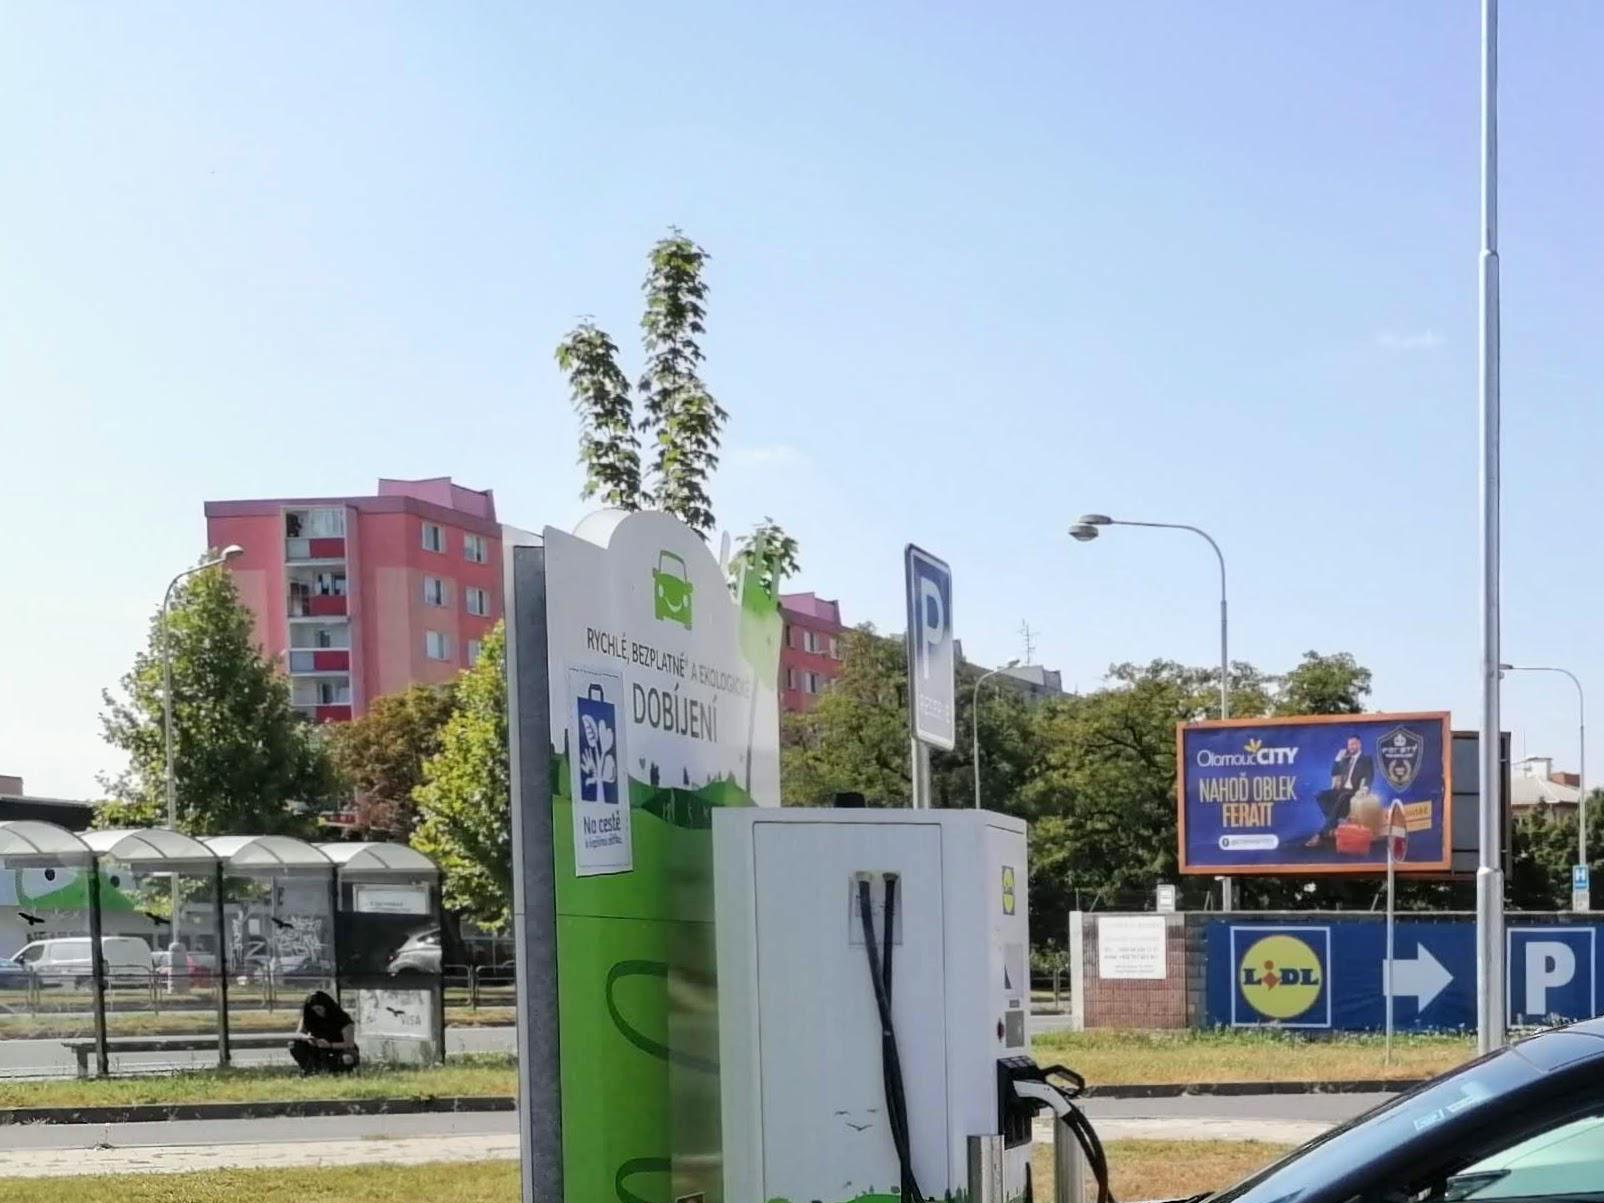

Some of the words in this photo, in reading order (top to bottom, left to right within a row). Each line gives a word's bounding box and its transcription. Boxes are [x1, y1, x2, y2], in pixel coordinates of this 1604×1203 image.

[587, 627, 630, 664] RYCHLÉ,
[920, 576, 944, 680] P
[632, 682, 718, 742] DOBÍJENÍ
[1253, 776, 1297, 801] OBLEK
[1525, 941, 1576, 1015] P
